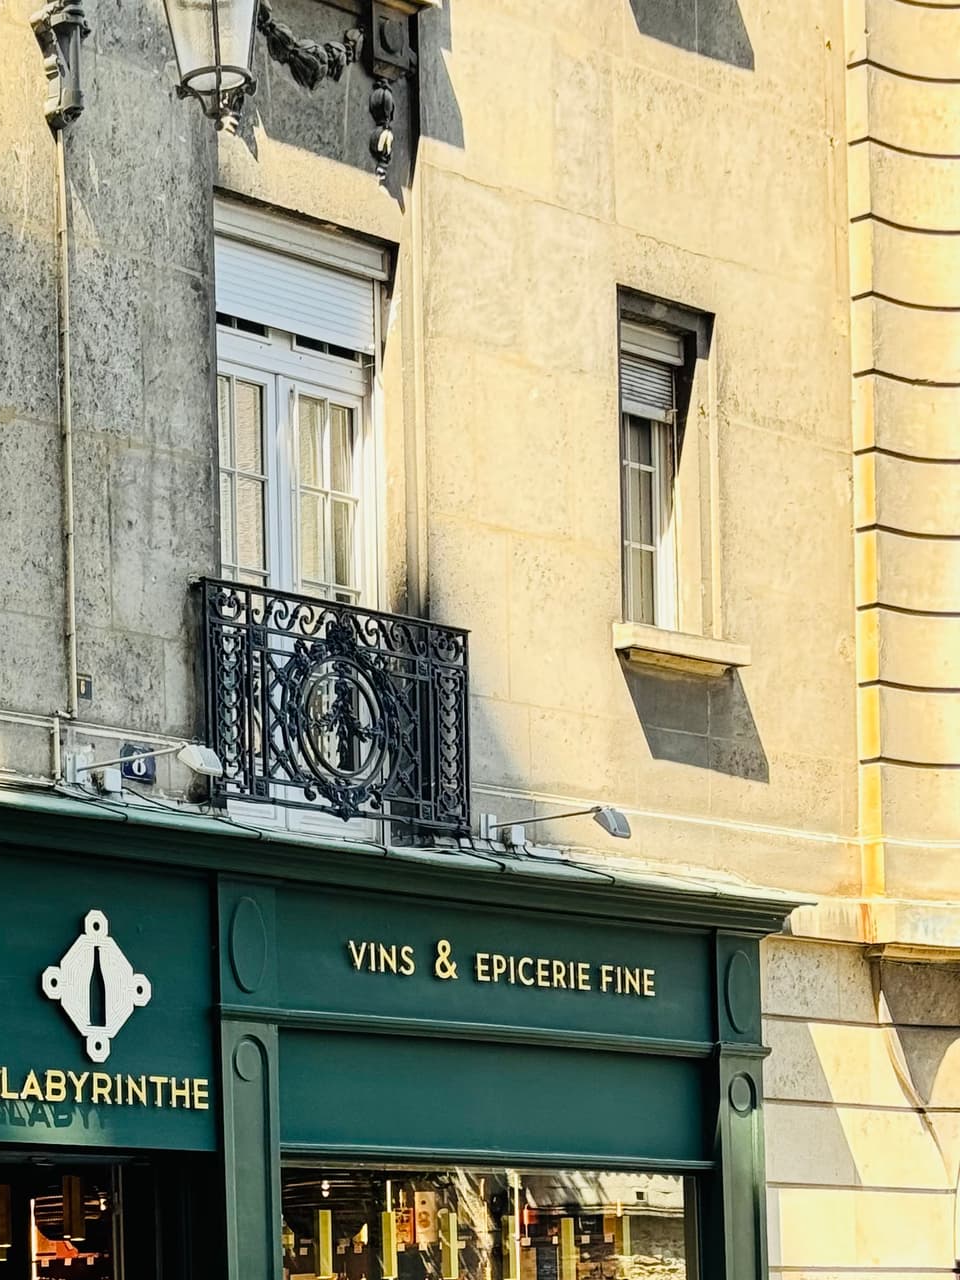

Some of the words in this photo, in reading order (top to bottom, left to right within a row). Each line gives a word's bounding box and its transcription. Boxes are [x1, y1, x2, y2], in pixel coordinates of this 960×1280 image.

[348, 940, 415, 976] VINS
[435, 939, 459, 980] &
[476, 952, 592, 991] EPICERIE
[600, 964, 656, 997] FINE
[0, 1066, 209, 1110] LABYRINTHE
